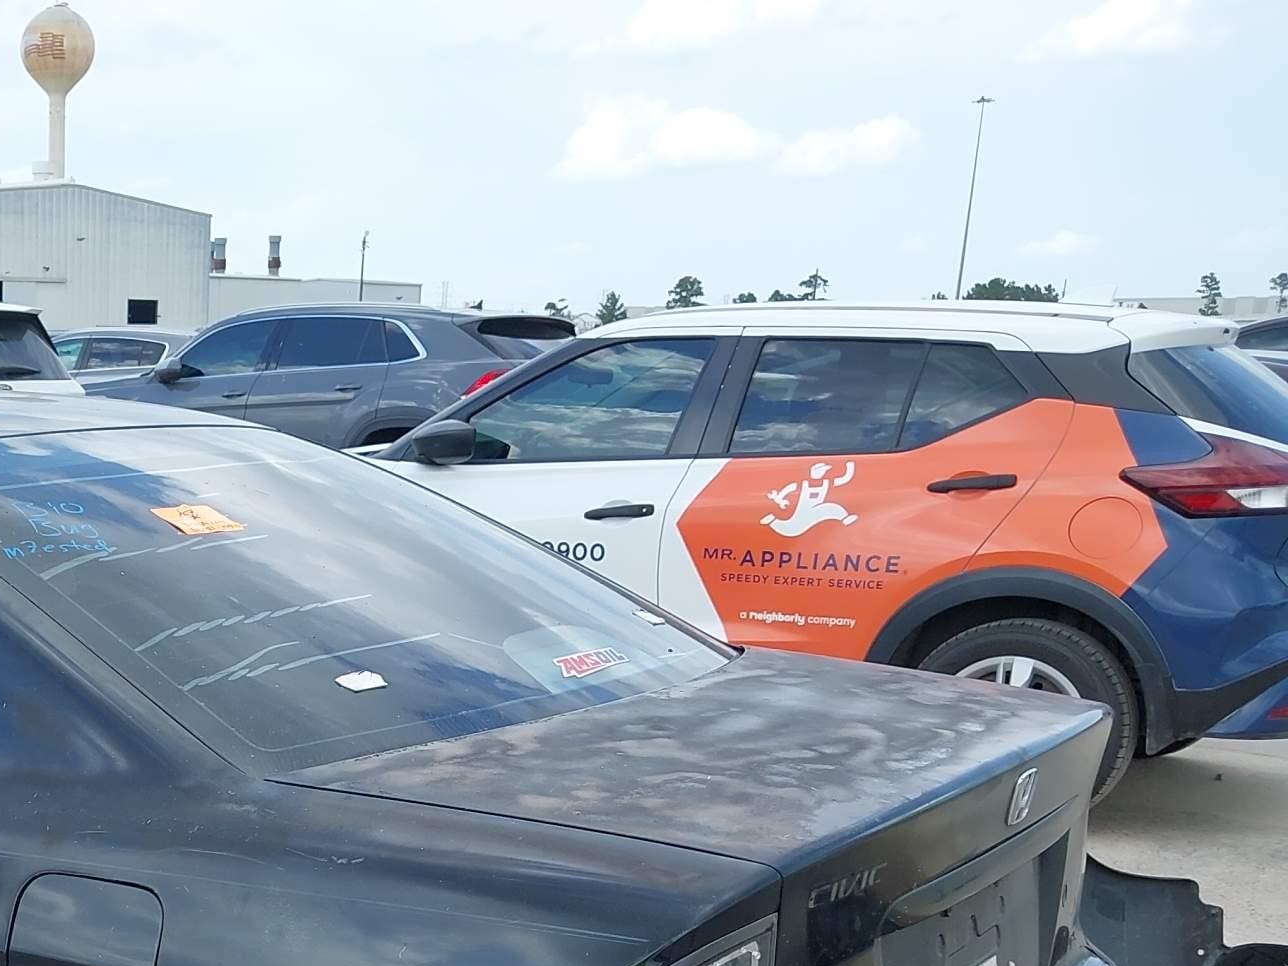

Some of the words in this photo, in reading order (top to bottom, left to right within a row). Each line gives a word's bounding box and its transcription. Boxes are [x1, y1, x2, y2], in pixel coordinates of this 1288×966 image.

[703, 547, 737, 561] MR.
[740, 550, 901, 573] APPLIANCE
[720, 573, 769, 584] SPEEDY
[774, 575, 822, 587] EXPERT
[828, 578, 884, 590] SERVICE
[739, 611, 747, 619] a
[807, 614, 856, 627] company
[556, 648, 625, 676] AMSOIL
